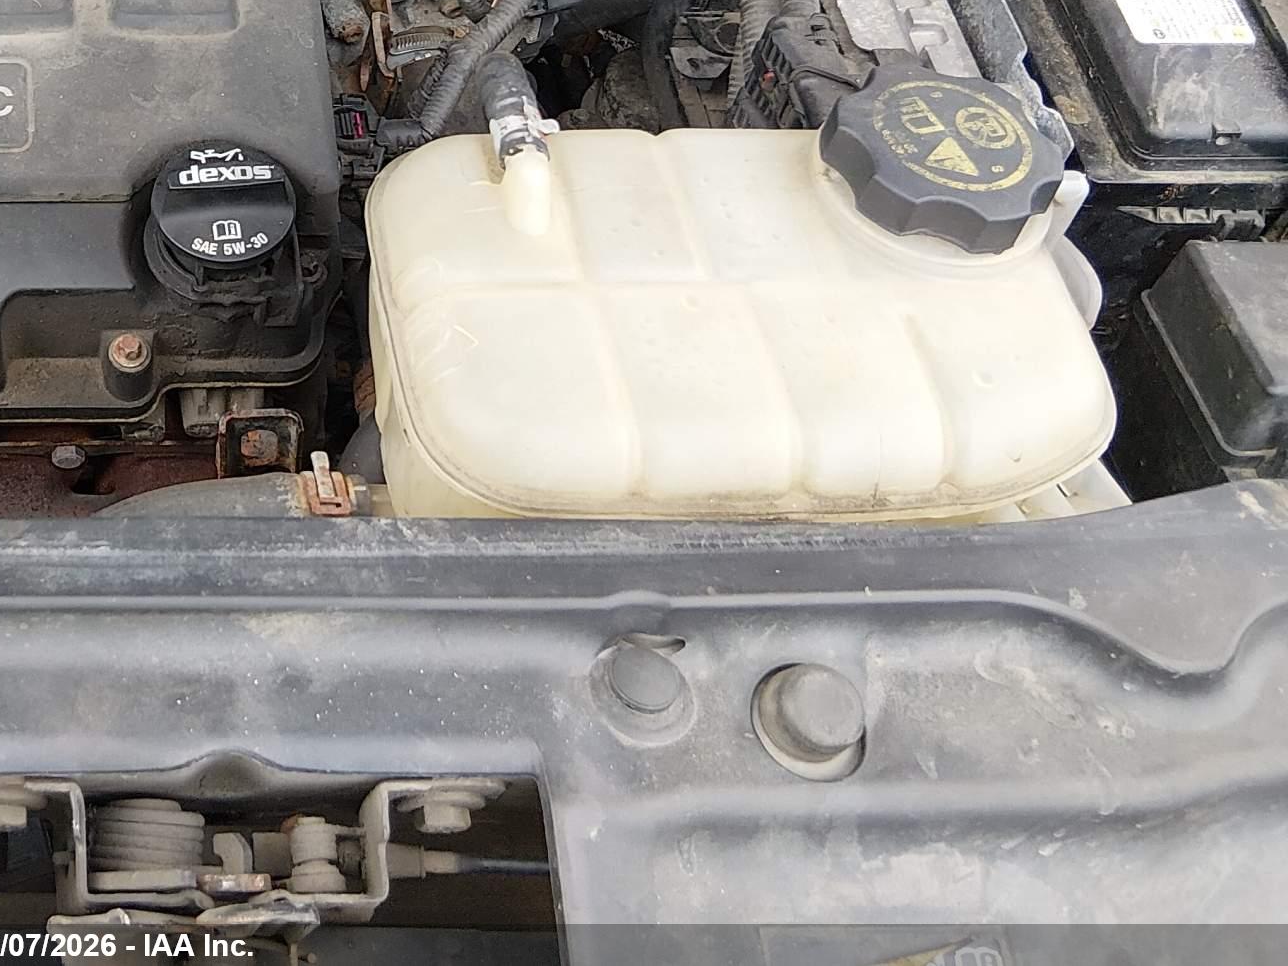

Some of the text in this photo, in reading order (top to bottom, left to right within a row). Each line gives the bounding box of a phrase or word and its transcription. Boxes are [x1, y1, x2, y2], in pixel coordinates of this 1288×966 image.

[178, 164, 273, 185] dexos
[192, 232, 269, 256] SAE 5W-30
